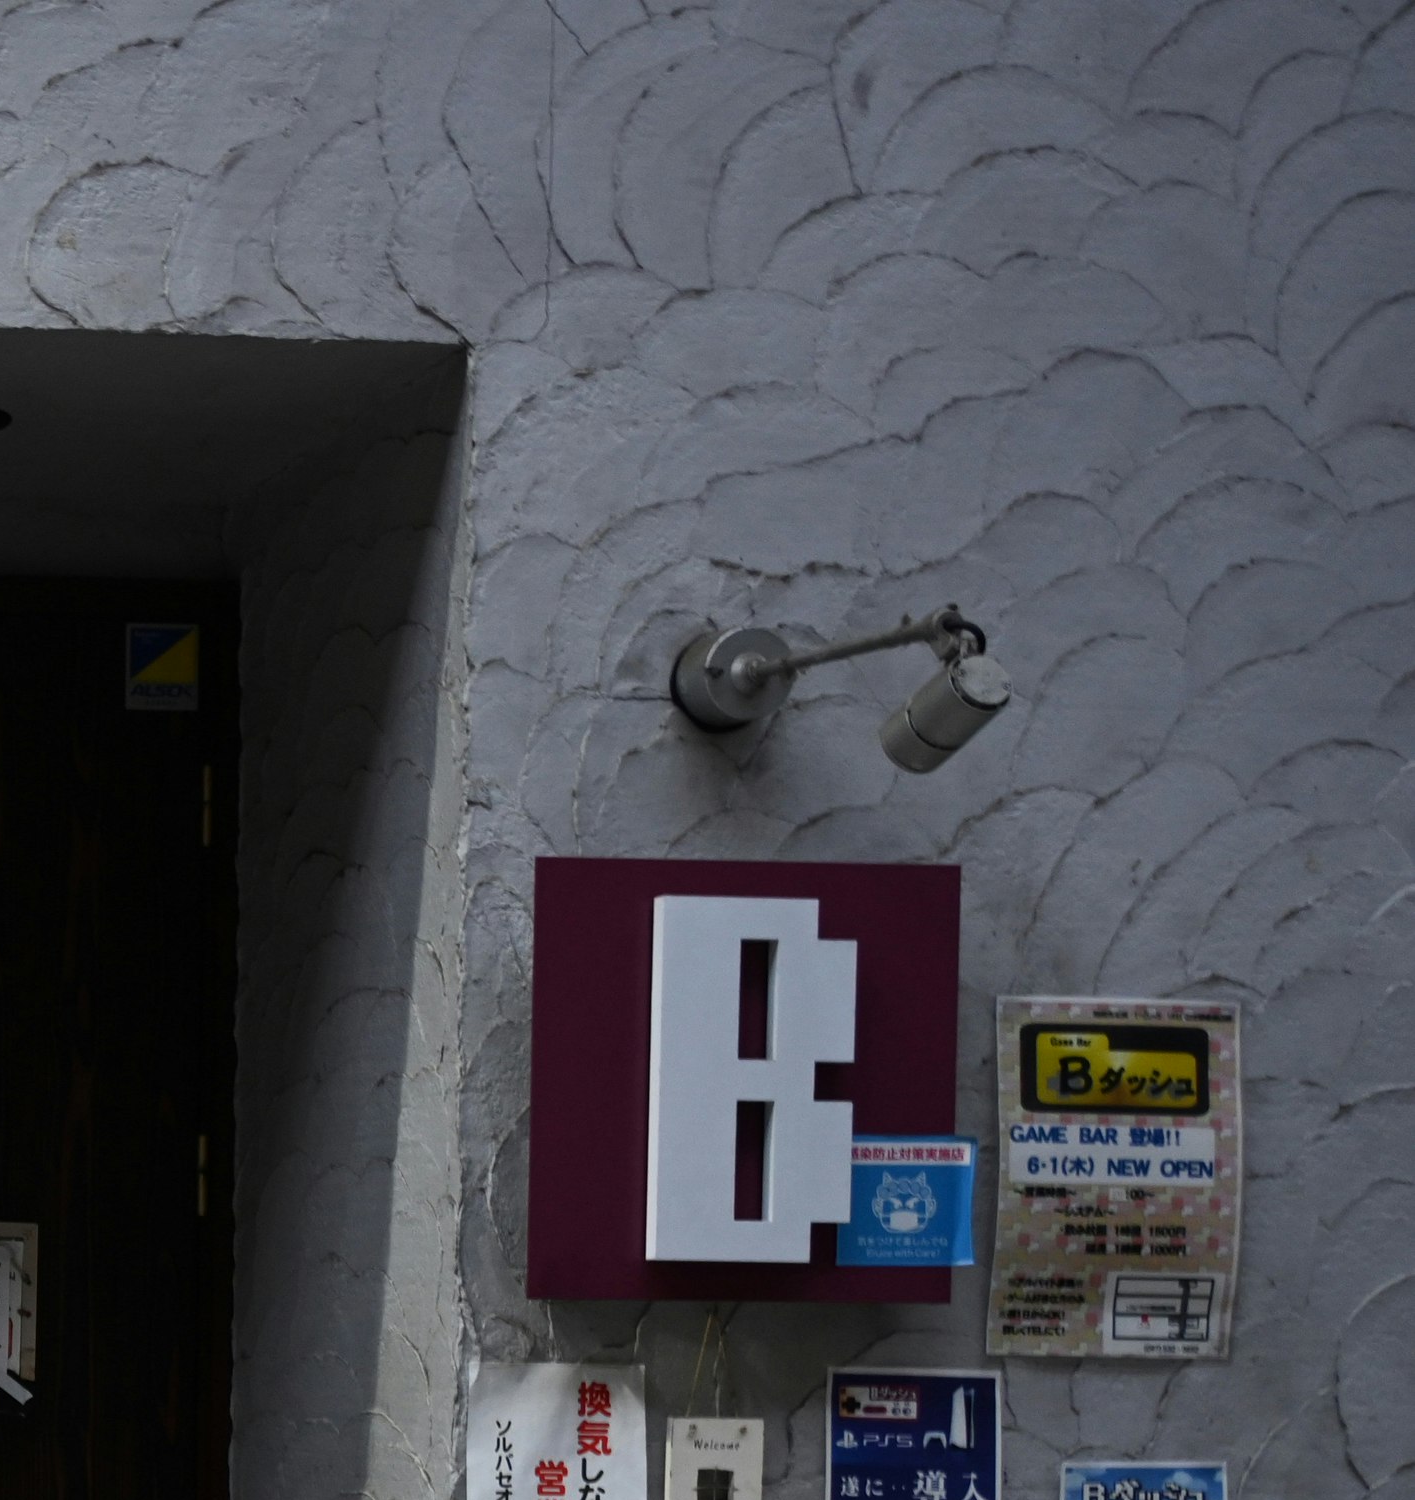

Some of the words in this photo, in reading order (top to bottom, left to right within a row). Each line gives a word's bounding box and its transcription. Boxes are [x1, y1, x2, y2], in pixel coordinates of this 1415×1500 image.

[646, 895, 858, 1264] B
[1058, 1056, 1195, 1096] Bダッシュ
[1010, 1125, 1068, 1144] GAME
[1079, 1127, 1118, 1145] BAR
[1106, 1158, 1151, 1177] NEW
[1160, 1159, 1214, 1179] OPEN
[863, 1433, 914, 1448] PS5
